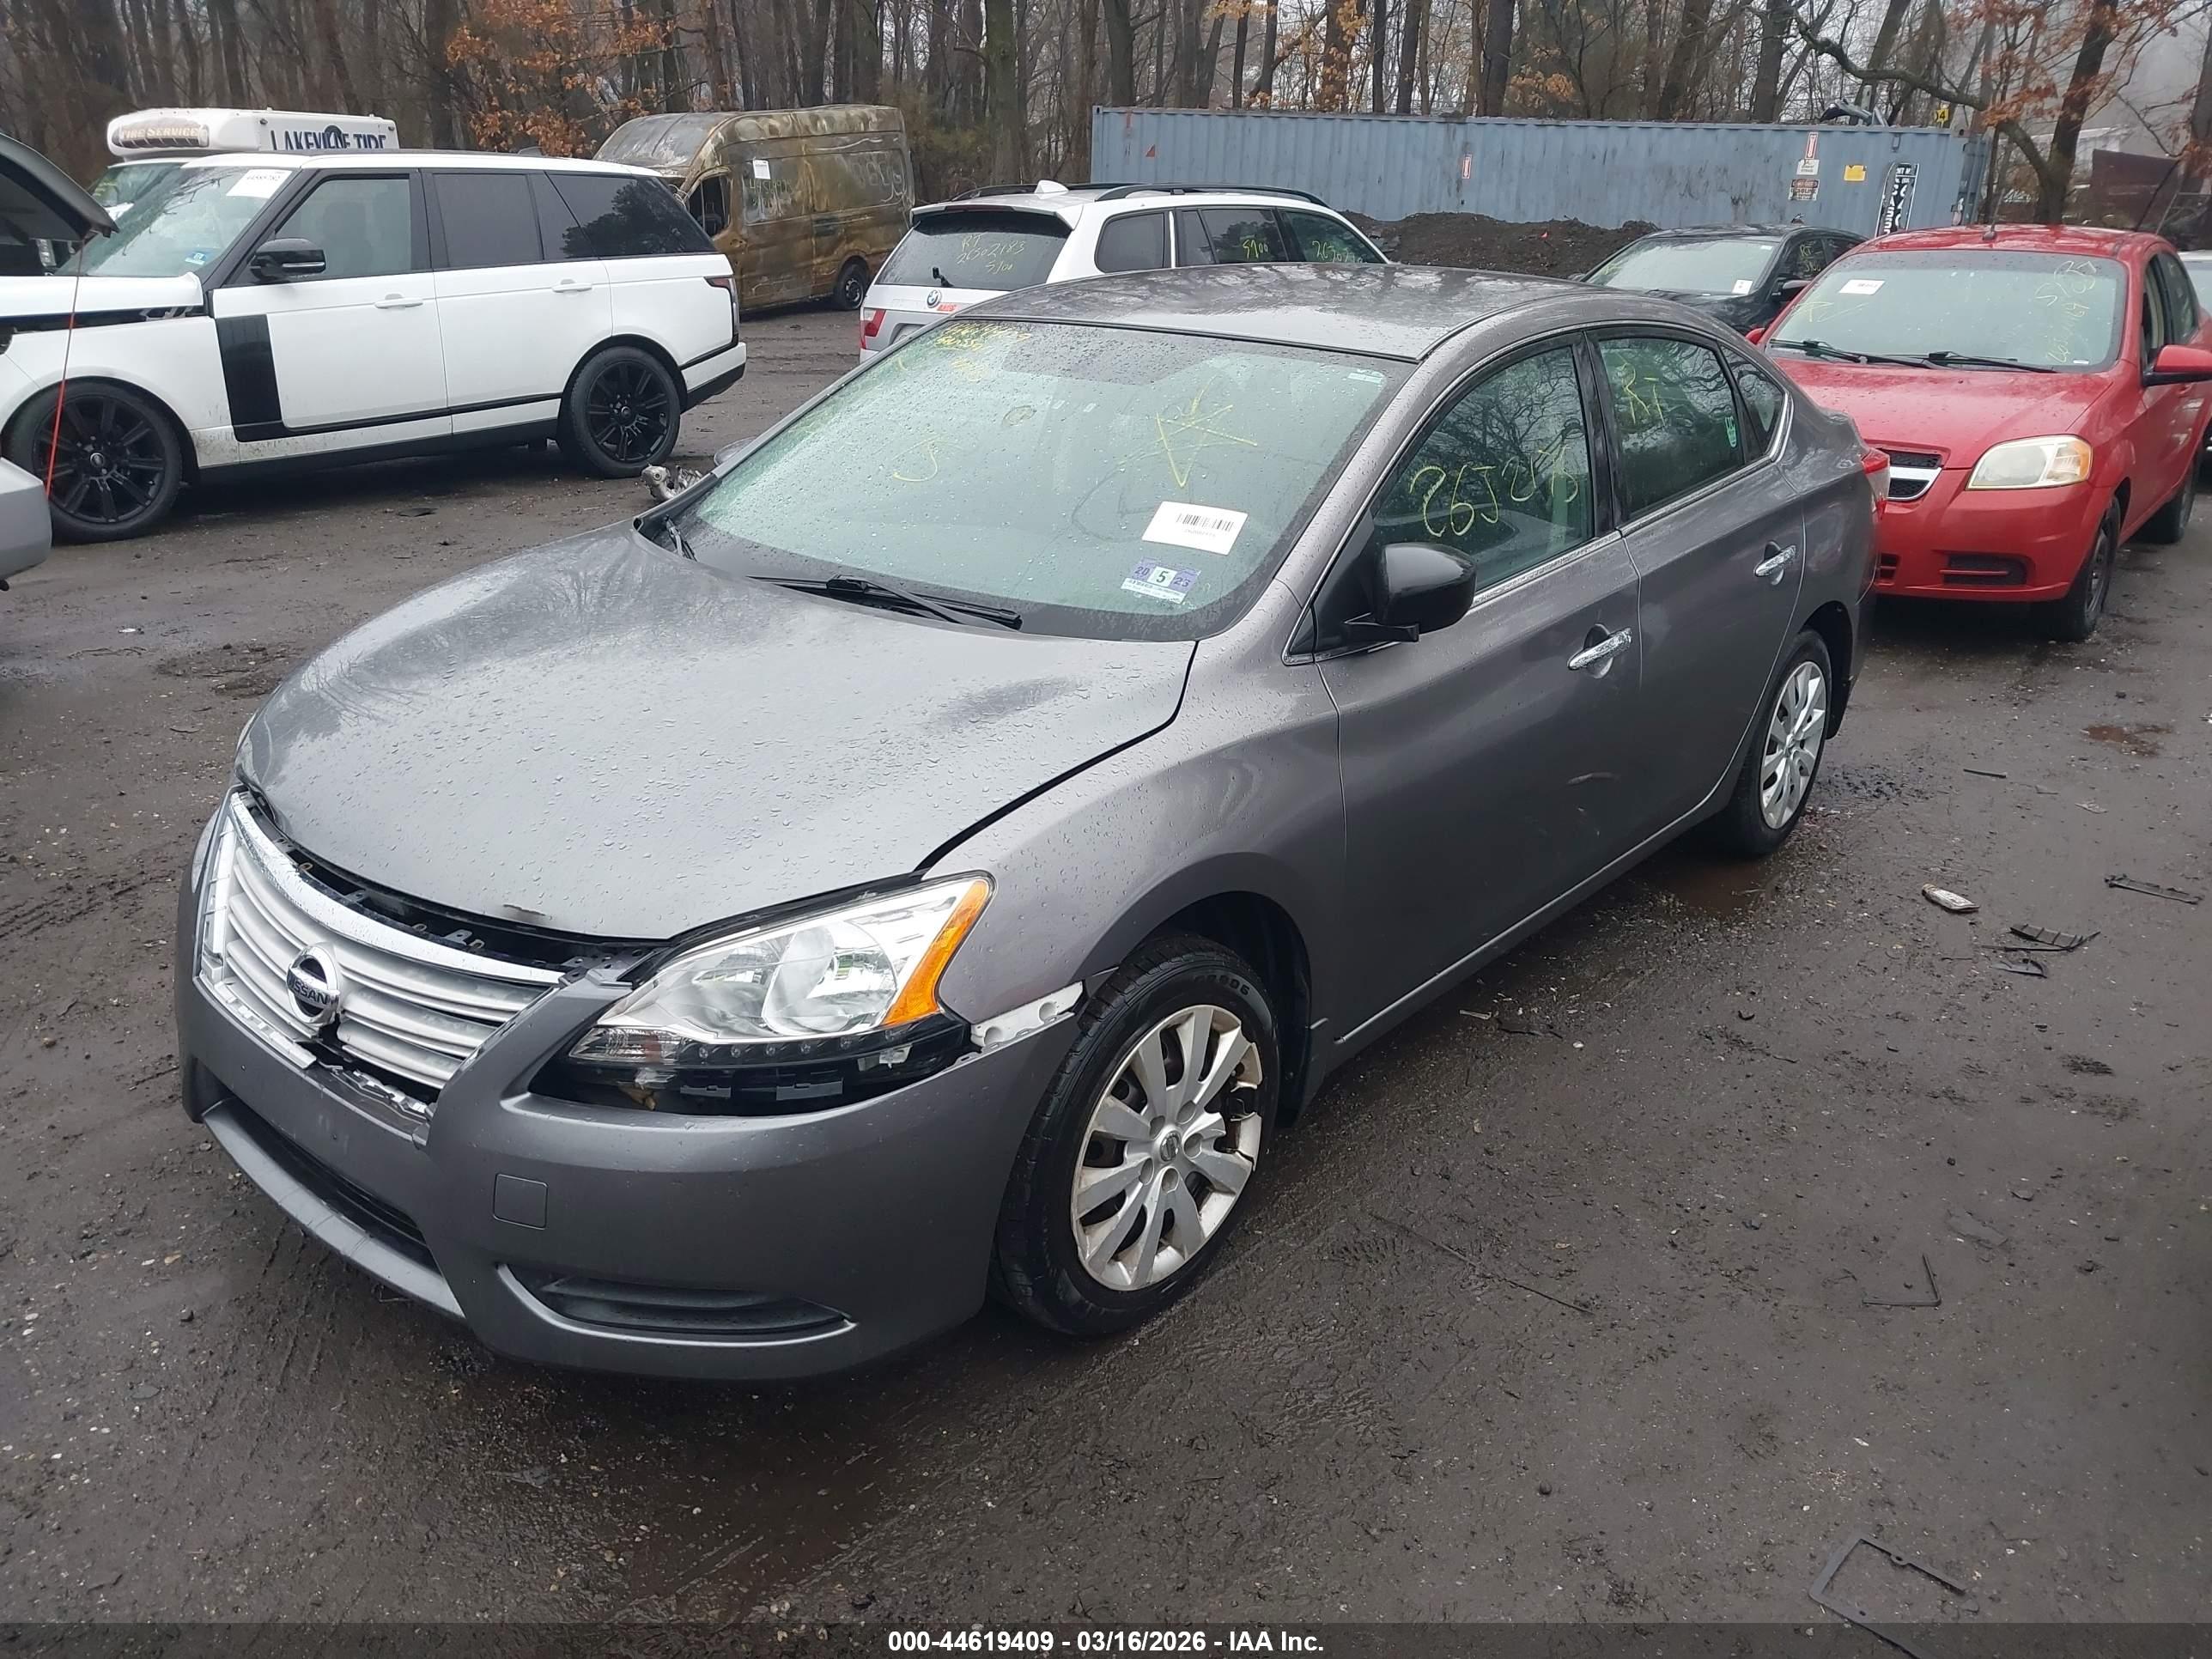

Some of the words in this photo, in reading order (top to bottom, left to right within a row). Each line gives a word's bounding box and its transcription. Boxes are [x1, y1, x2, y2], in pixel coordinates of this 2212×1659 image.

[147, 127, 199, 138] SERVICE
[1135, 566, 1151, 576] 20
[1156, 570, 1169, 583] 5
